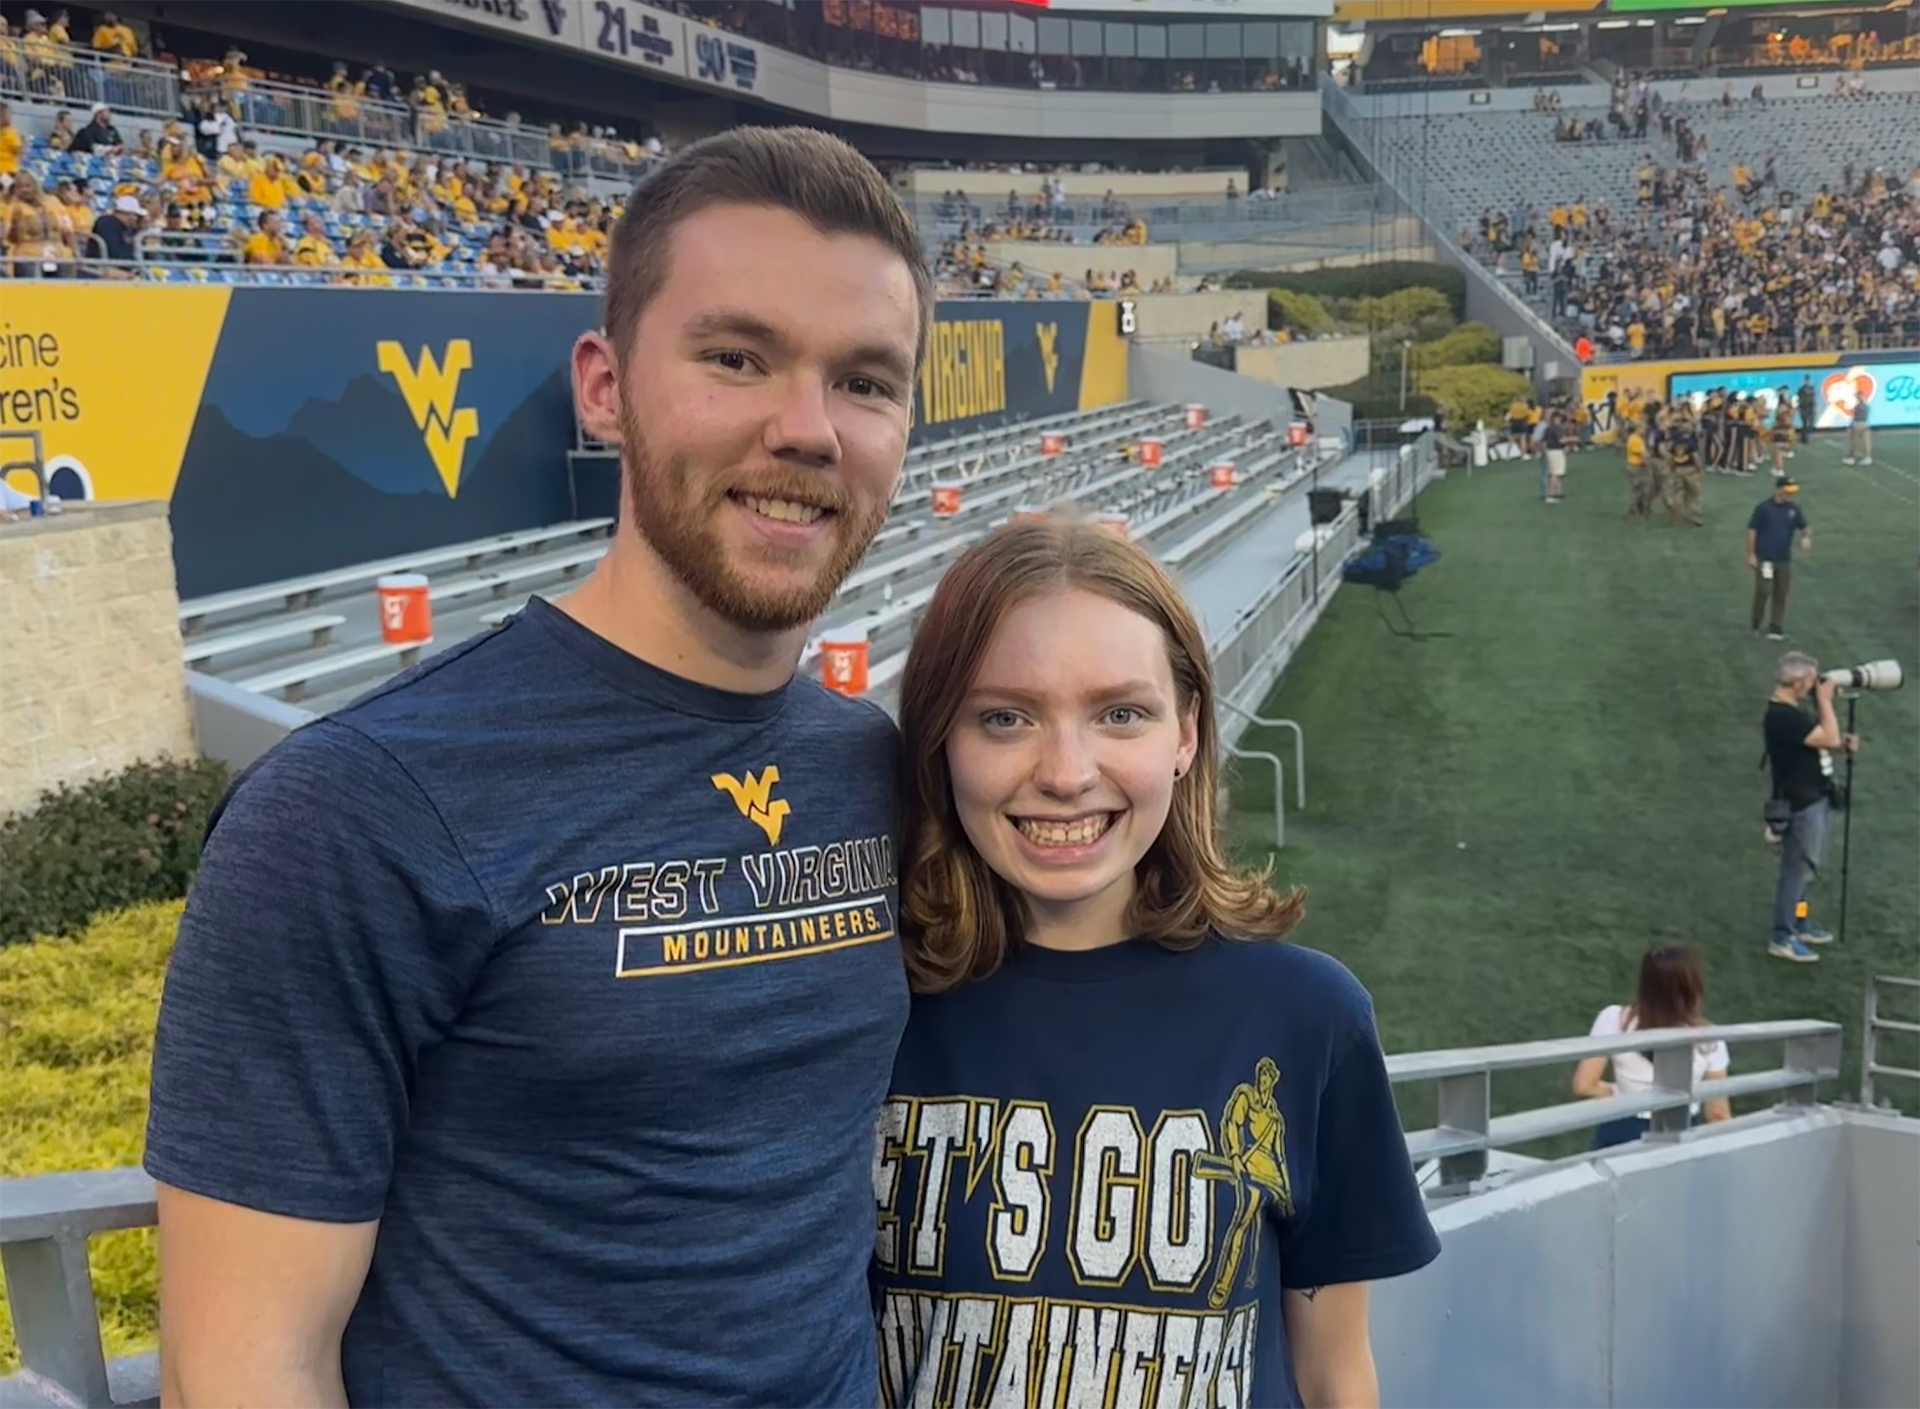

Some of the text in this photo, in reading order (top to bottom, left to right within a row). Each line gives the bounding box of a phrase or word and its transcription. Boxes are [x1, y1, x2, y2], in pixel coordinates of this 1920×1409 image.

[596, 1, 628, 55] 21
[695, 32, 726, 82] 90
[541, 834, 898, 925] WEST VIRGINIA
[1065, 1104, 1216, 1294] GO
